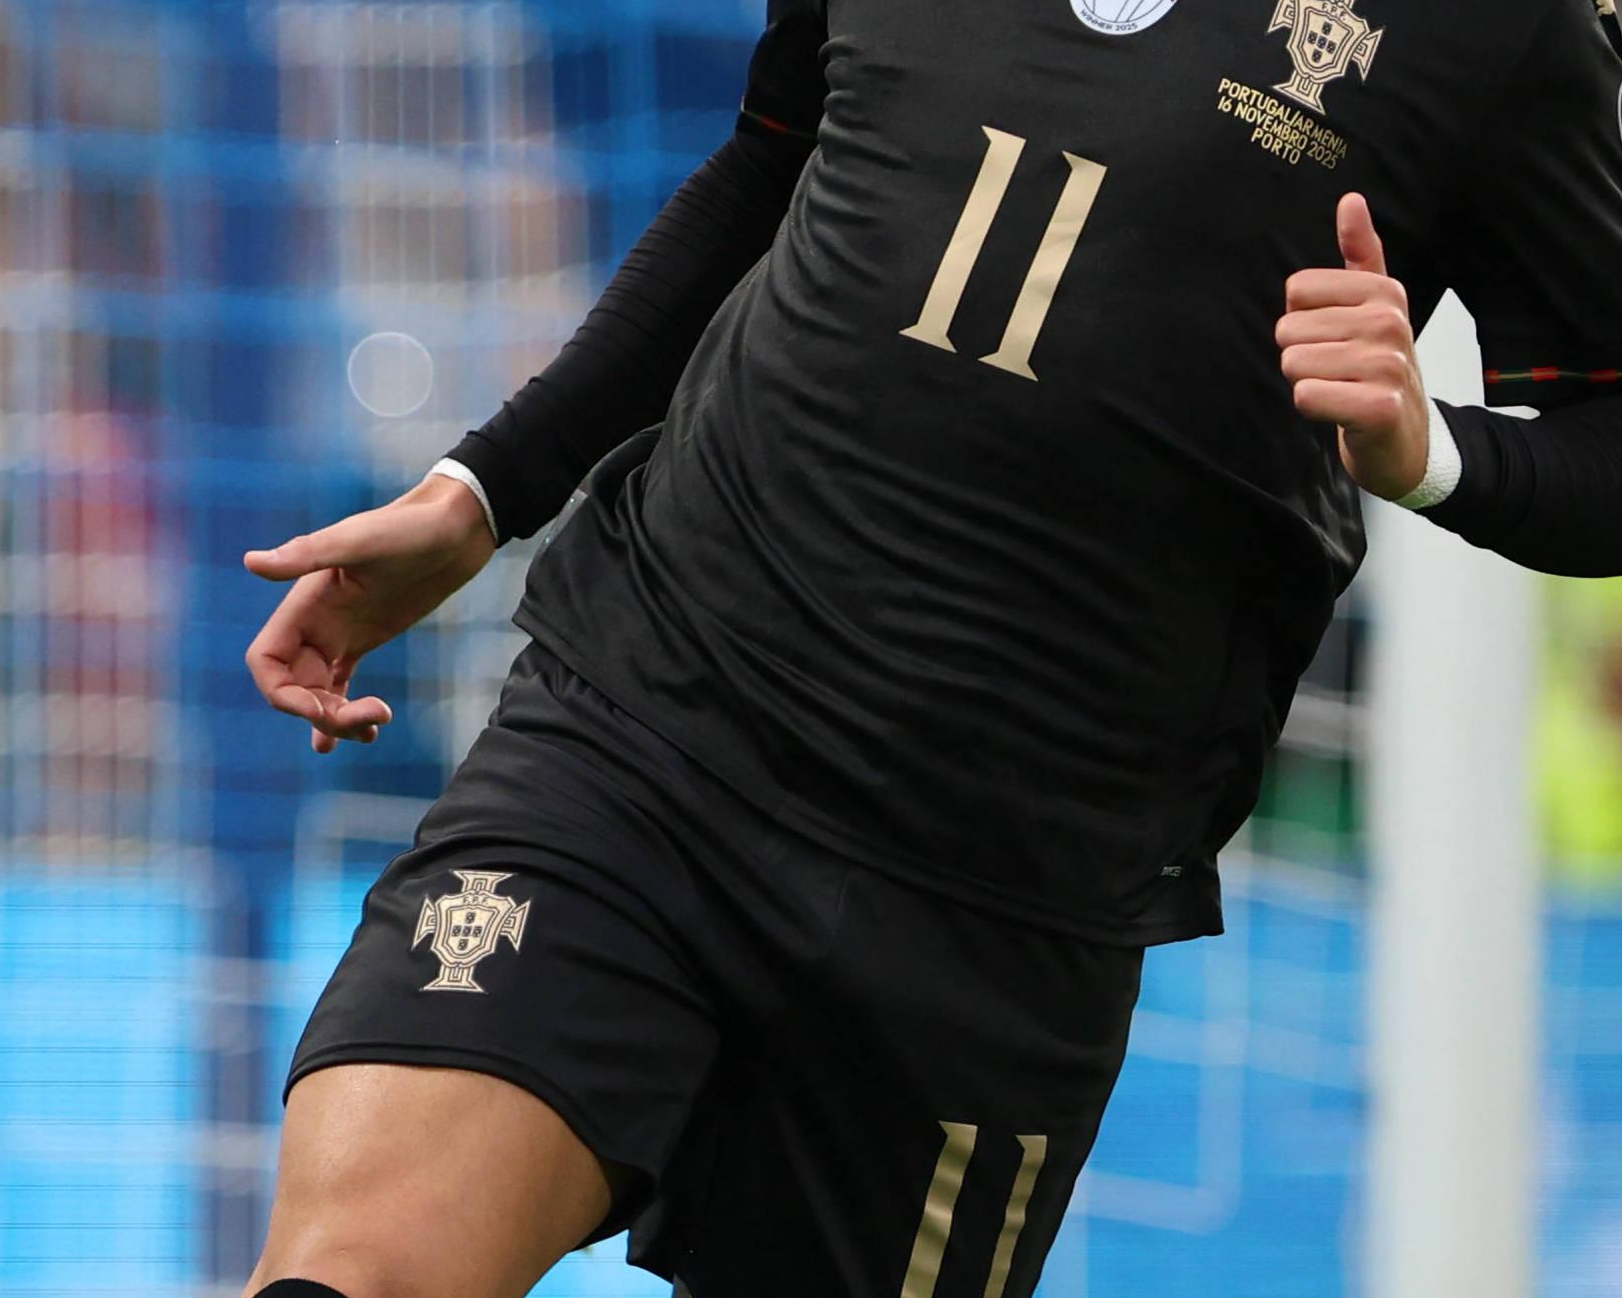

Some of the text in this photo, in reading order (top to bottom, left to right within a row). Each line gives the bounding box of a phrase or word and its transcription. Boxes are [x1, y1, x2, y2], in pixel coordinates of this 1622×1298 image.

[1081, 9, 1138, 32] WINNER 2025
[1218, 96, 1339, 169] 16 NOVEMBRO 2025
[1251, 128, 1301, 165] PORTO
[898, 125, 1107, 382] 11
